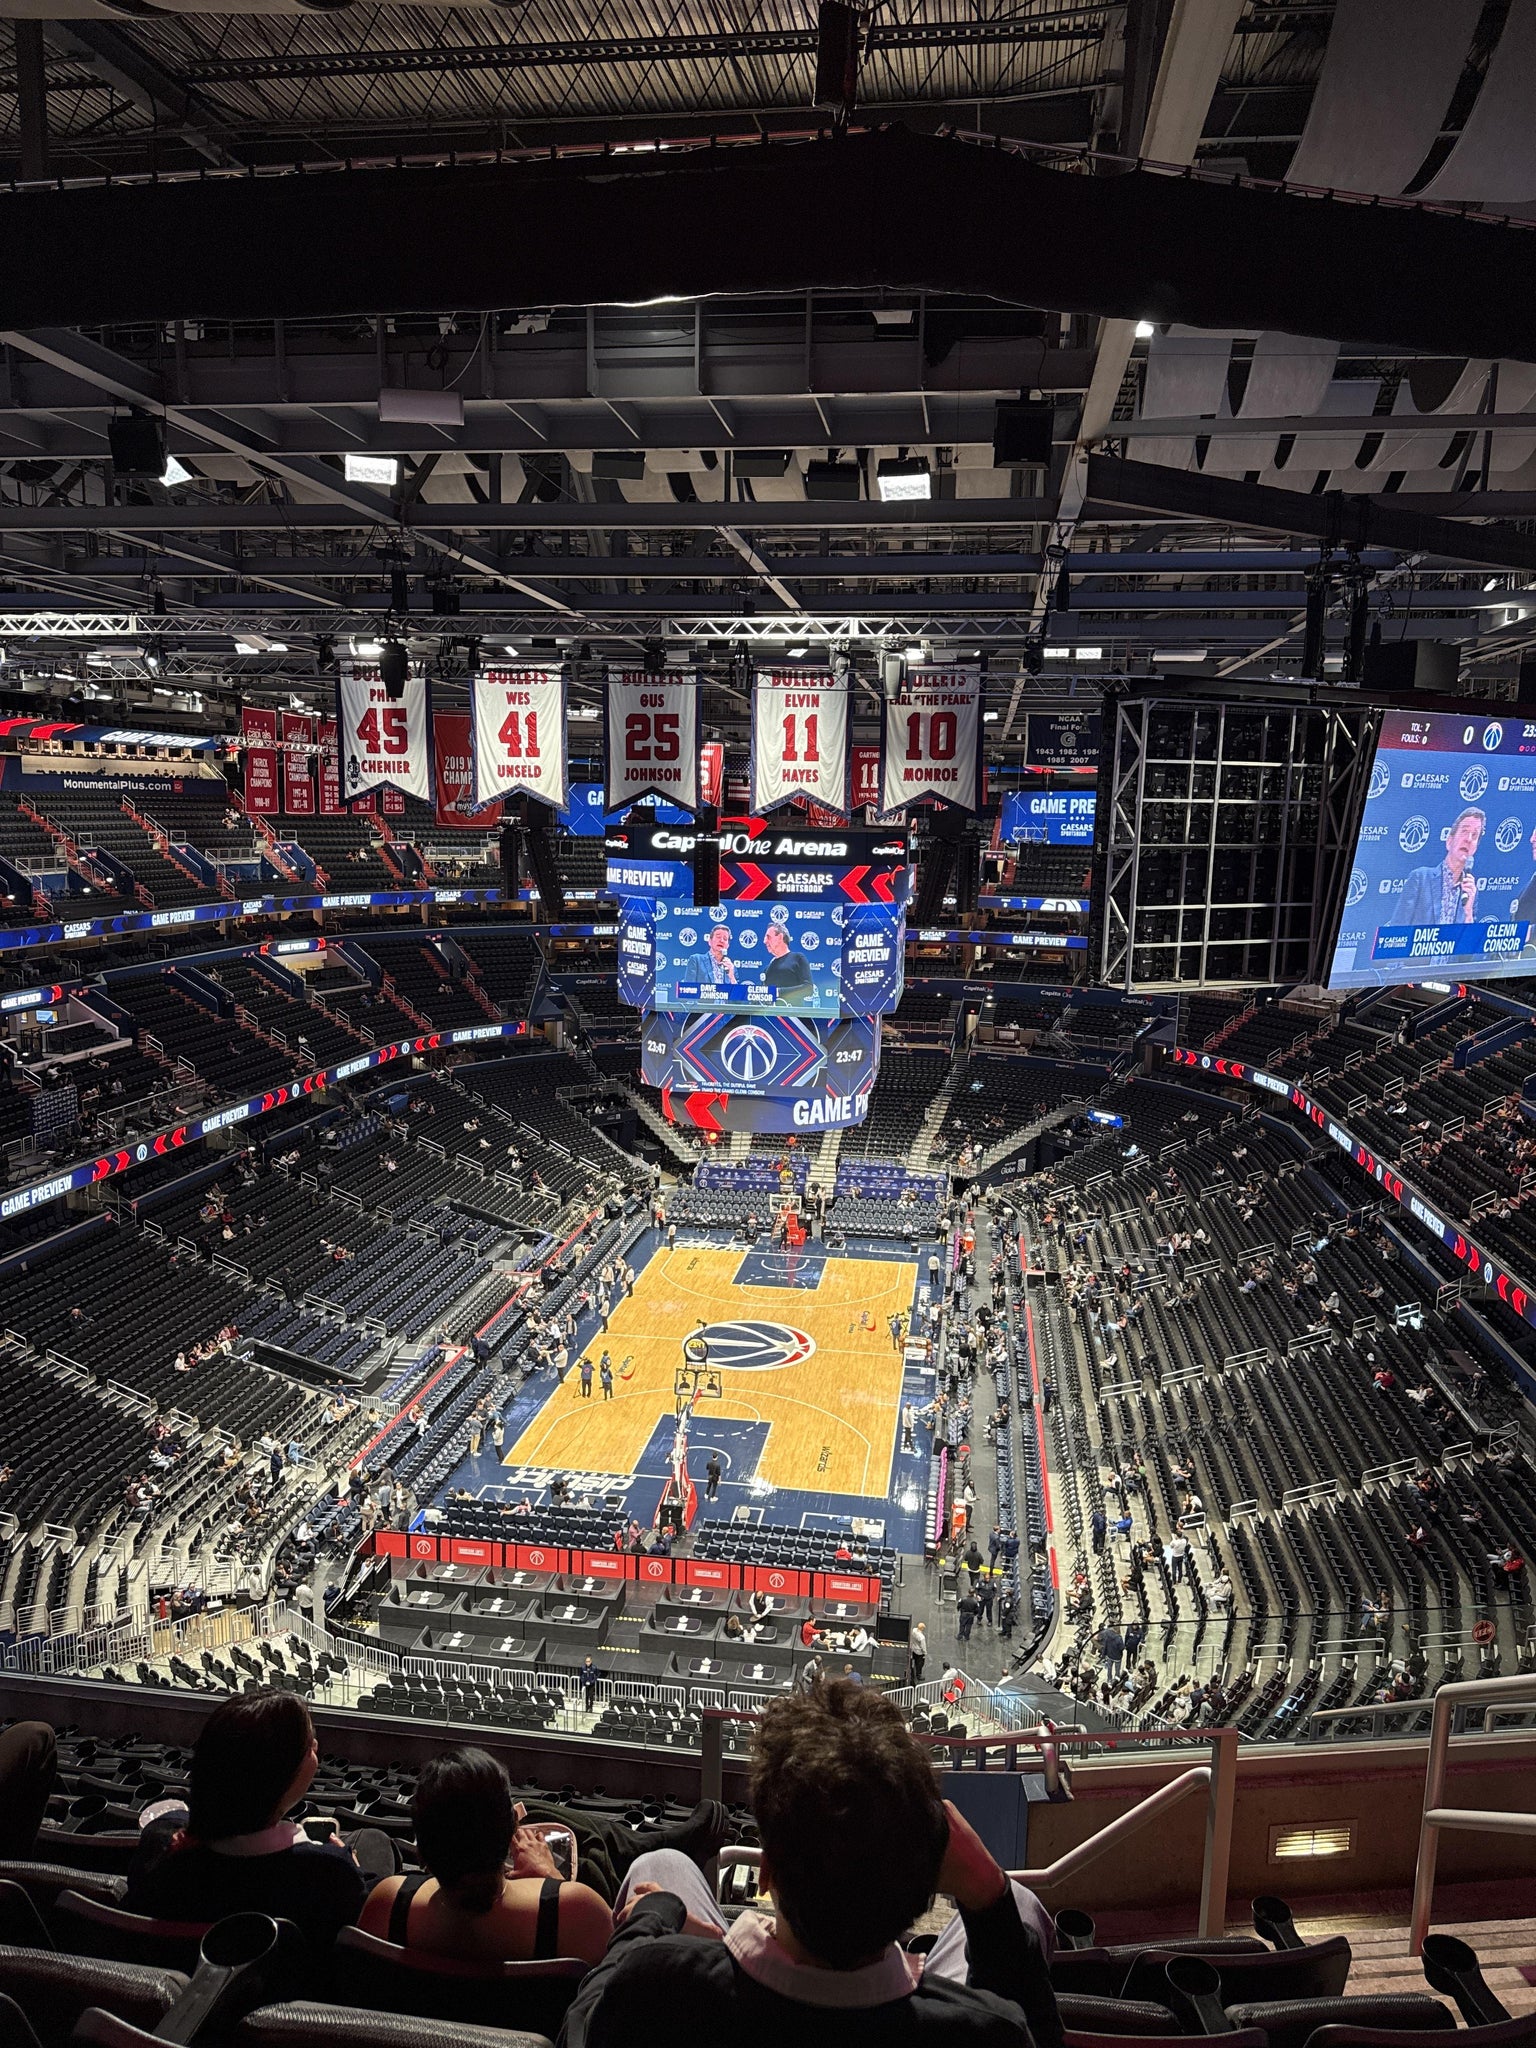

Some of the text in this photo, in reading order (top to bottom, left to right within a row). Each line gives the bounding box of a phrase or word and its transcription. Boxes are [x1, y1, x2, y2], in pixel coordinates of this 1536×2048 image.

[772, 671, 835, 687] BULLETS
[902, 675, 967, 688] ULLETS
[506, 692, 530, 705] WES
[639, 693, 665, 707] GUS
[785, 694, 820, 708] ELVIN
[357, 708, 408, 754] 45
[498, 711, 541, 758] 41
[1050, 723, 1069, 731] Final
[1411, 722, 1431, 732] TOL: 7
[625, 713, 680, 761] 25
[782, 714, 820, 762] 11
[906, 711, 957, 760] 10
[1463, 726, 1474, 745] 0
[361, 760, 410, 774] CHENIER
[444, 756, 465, 770] 2019
[443, 770, 473, 785] CHAMP
[497, 765, 542, 778] UNSELD
[624, 767, 682, 782] JOHNSON
[781, 767, 819, 783] HAYES
[861, 763, 879, 788] 11
[903, 768, 959, 782] MONROE
[1414, 773, 1450, 784] CAESARS
[63, 778, 172, 791] MonumentalPlus.com
[1030, 799, 1066, 814] GAME
[1060, 824, 1093, 832] CAESARS
[775, 838, 848, 857] Arena
[623, 869, 674, 888] PREVIEW
[776, 873, 834, 886] CAESARS
[1488, 876, 1520, 886] CAESARS
[776, 884, 823, 893] SPORTSBOOK
[322, 895, 371, 907] GAME PREVIEW
[151, 910, 196, 926] GAME PREVIEW
[594, 926, 614, 935] GAME
[627, 925, 647, 941] GAME
[1413, 928, 1440, 943] DAVE
[1487, 924, 1518, 939] GLENN
[855, 933, 884, 948] GAME
[1013, 935, 1067, 947] GAME PREVIEW
[1384, 936, 1408, 945] CAESARS
[1483, 938, 1521, 954] CONSOR
[622, 940, 652, 957] PREVIEW
[848, 948, 890, 963] PREVIEW
[1409, 941, 1456, 957] JOHNSON
[854, 970, 884, 979] CAESARS
[700, 984, 717, 992] DAVE
[700, 991, 729, 1000] JOHNSON
[747, 985, 769, 994] GLENN
[747, 993, 773, 1002] CONSOR
[453, 1026, 502, 1042] GAME PREVIEW
[647, 1040, 666, 1055] 23:47
[836, 1050, 863, 1064] 23:47
[202, 1104, 249, 1133] GAME PREVIEW
[793, 1096, 851, 1126] GAME
[1, 1175, 73, 1217] GAME PREVIEW
